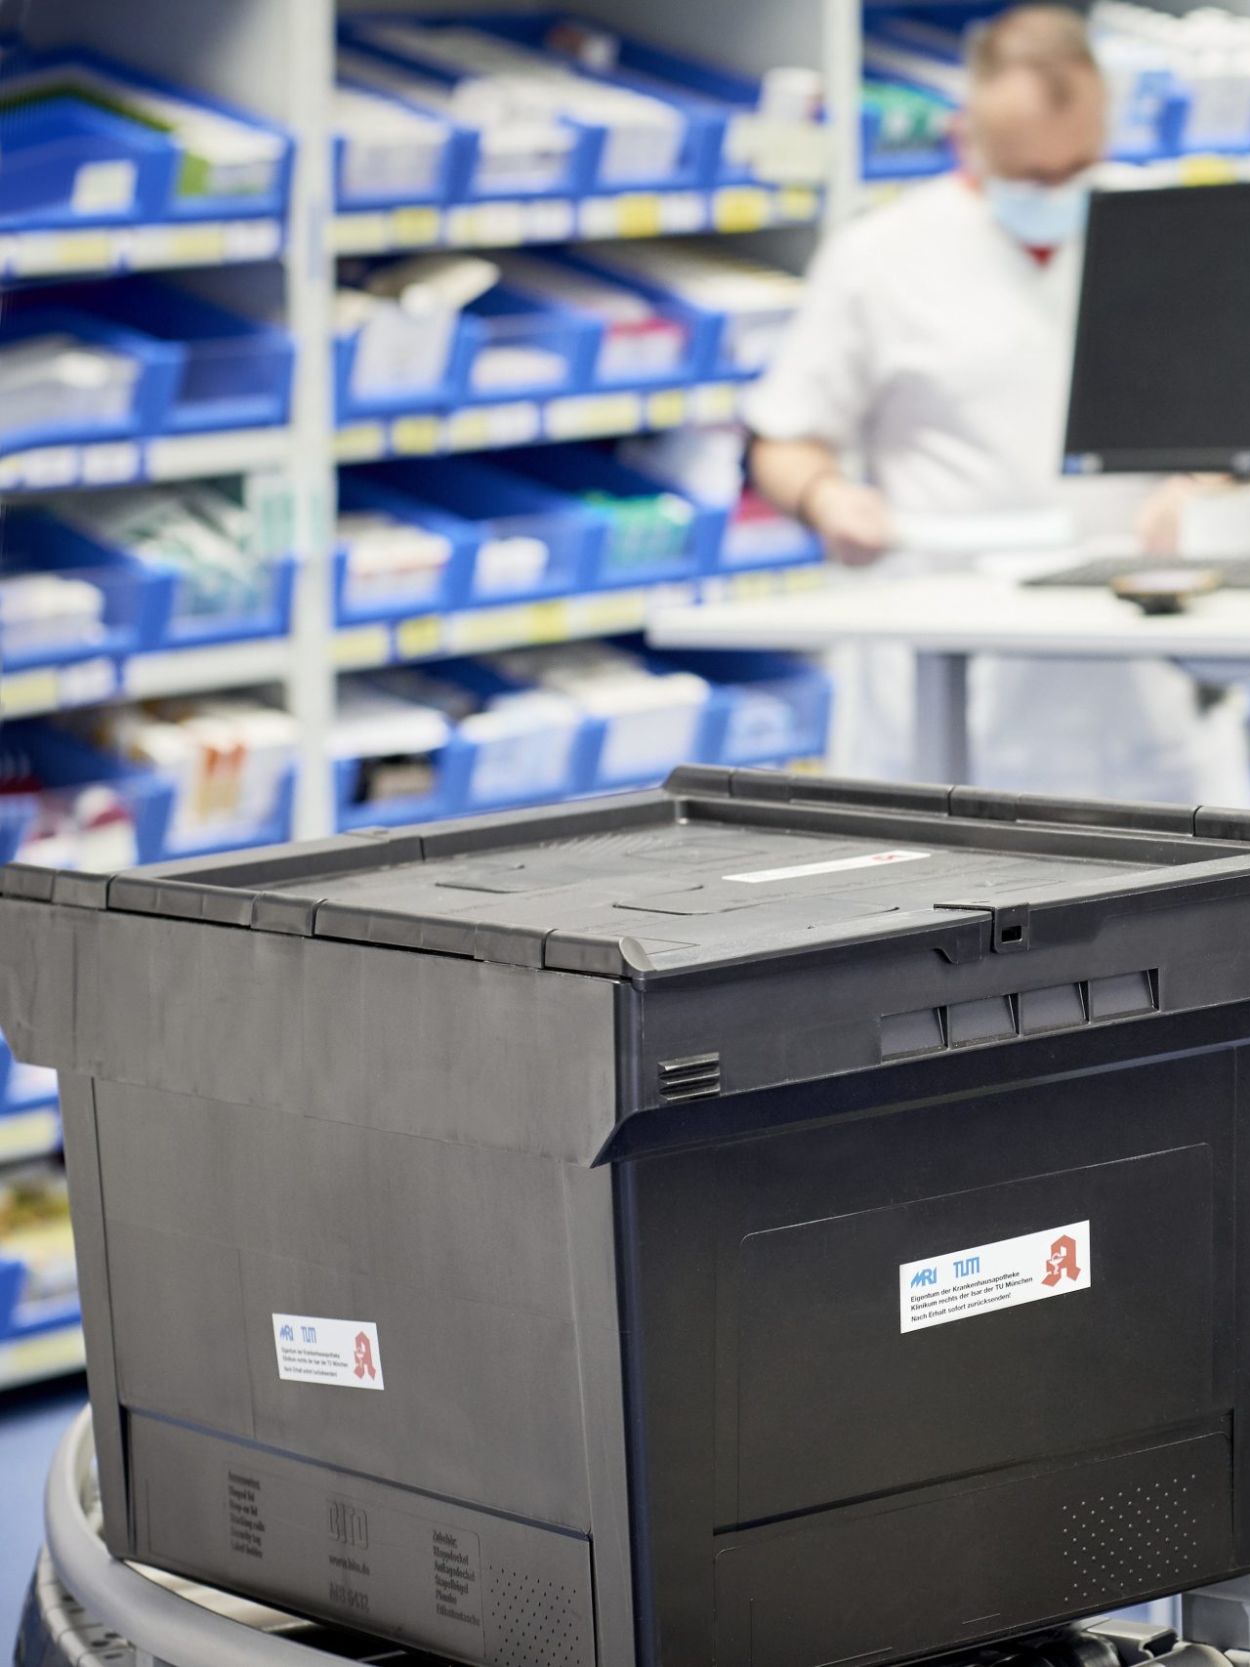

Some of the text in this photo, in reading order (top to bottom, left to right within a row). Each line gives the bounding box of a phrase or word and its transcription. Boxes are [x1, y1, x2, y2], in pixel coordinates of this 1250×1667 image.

[910, 1266, 937, 1288] MRI
[953, 1256, 980, 1278] TUM
[910, 1271, 1020, 1303] Eigentum der Krankenhausapotheke
[910, 1276, 1033, 1311] Klinikum rechts der Isar der TU München
[911, 1291, 1012, 1323] Nach Erhalt sofort zurücksenden!
[300, 1326, 318, 1344] TUM
